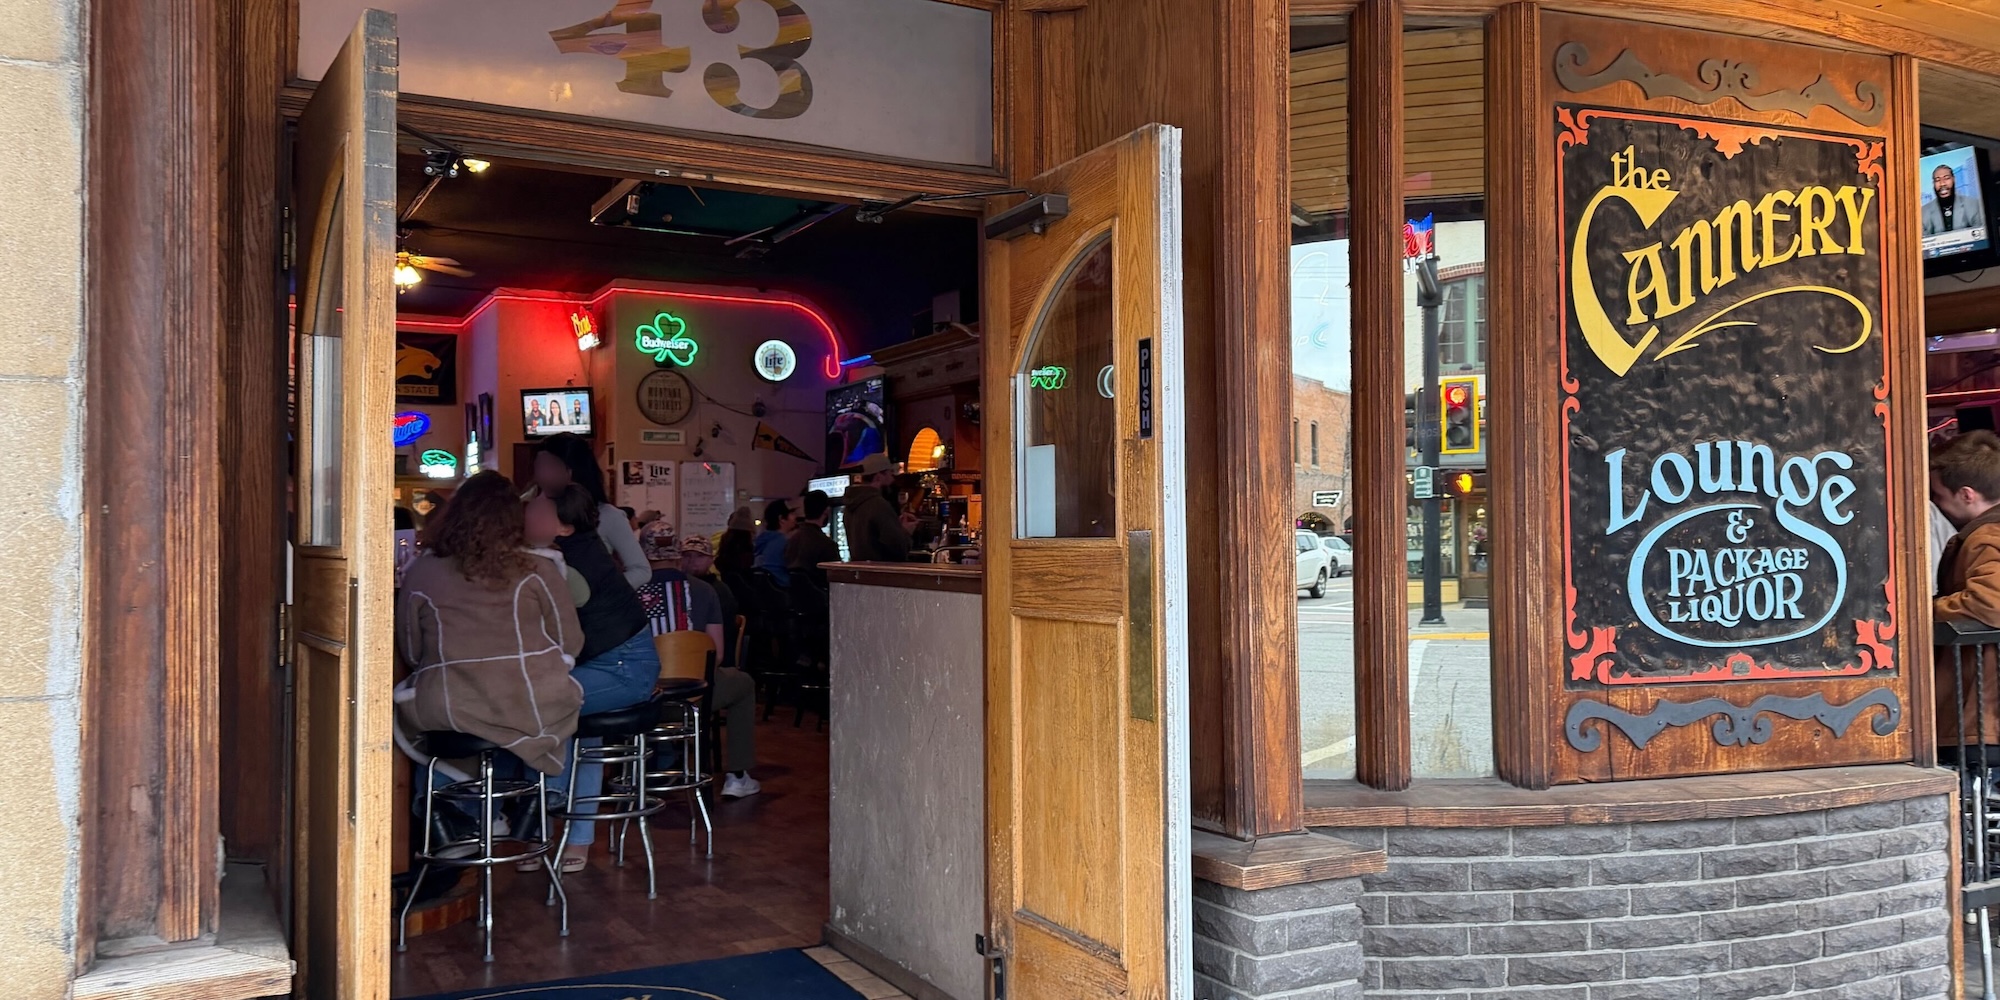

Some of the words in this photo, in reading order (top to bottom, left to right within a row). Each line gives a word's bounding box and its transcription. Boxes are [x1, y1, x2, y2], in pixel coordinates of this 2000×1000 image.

[548, 0, 813, 119] 43
[1610, 144, 1672, 190] the
[1571, 184, 1875, 378] CANNERY
[641, 335, 689, 349] Budweiser
[404, 385, 435, 394] STATE
[1141, 348, 1150, 429] PUSH
[650, 464, 671, 478] Lite
[1604, 440, 1857, 536] Lounge
[1726, 509, 1755, 544] &
[1667, 547, 1809, 598] PACKAGE
[1667, 572, 1805, 628] LIQUOR
